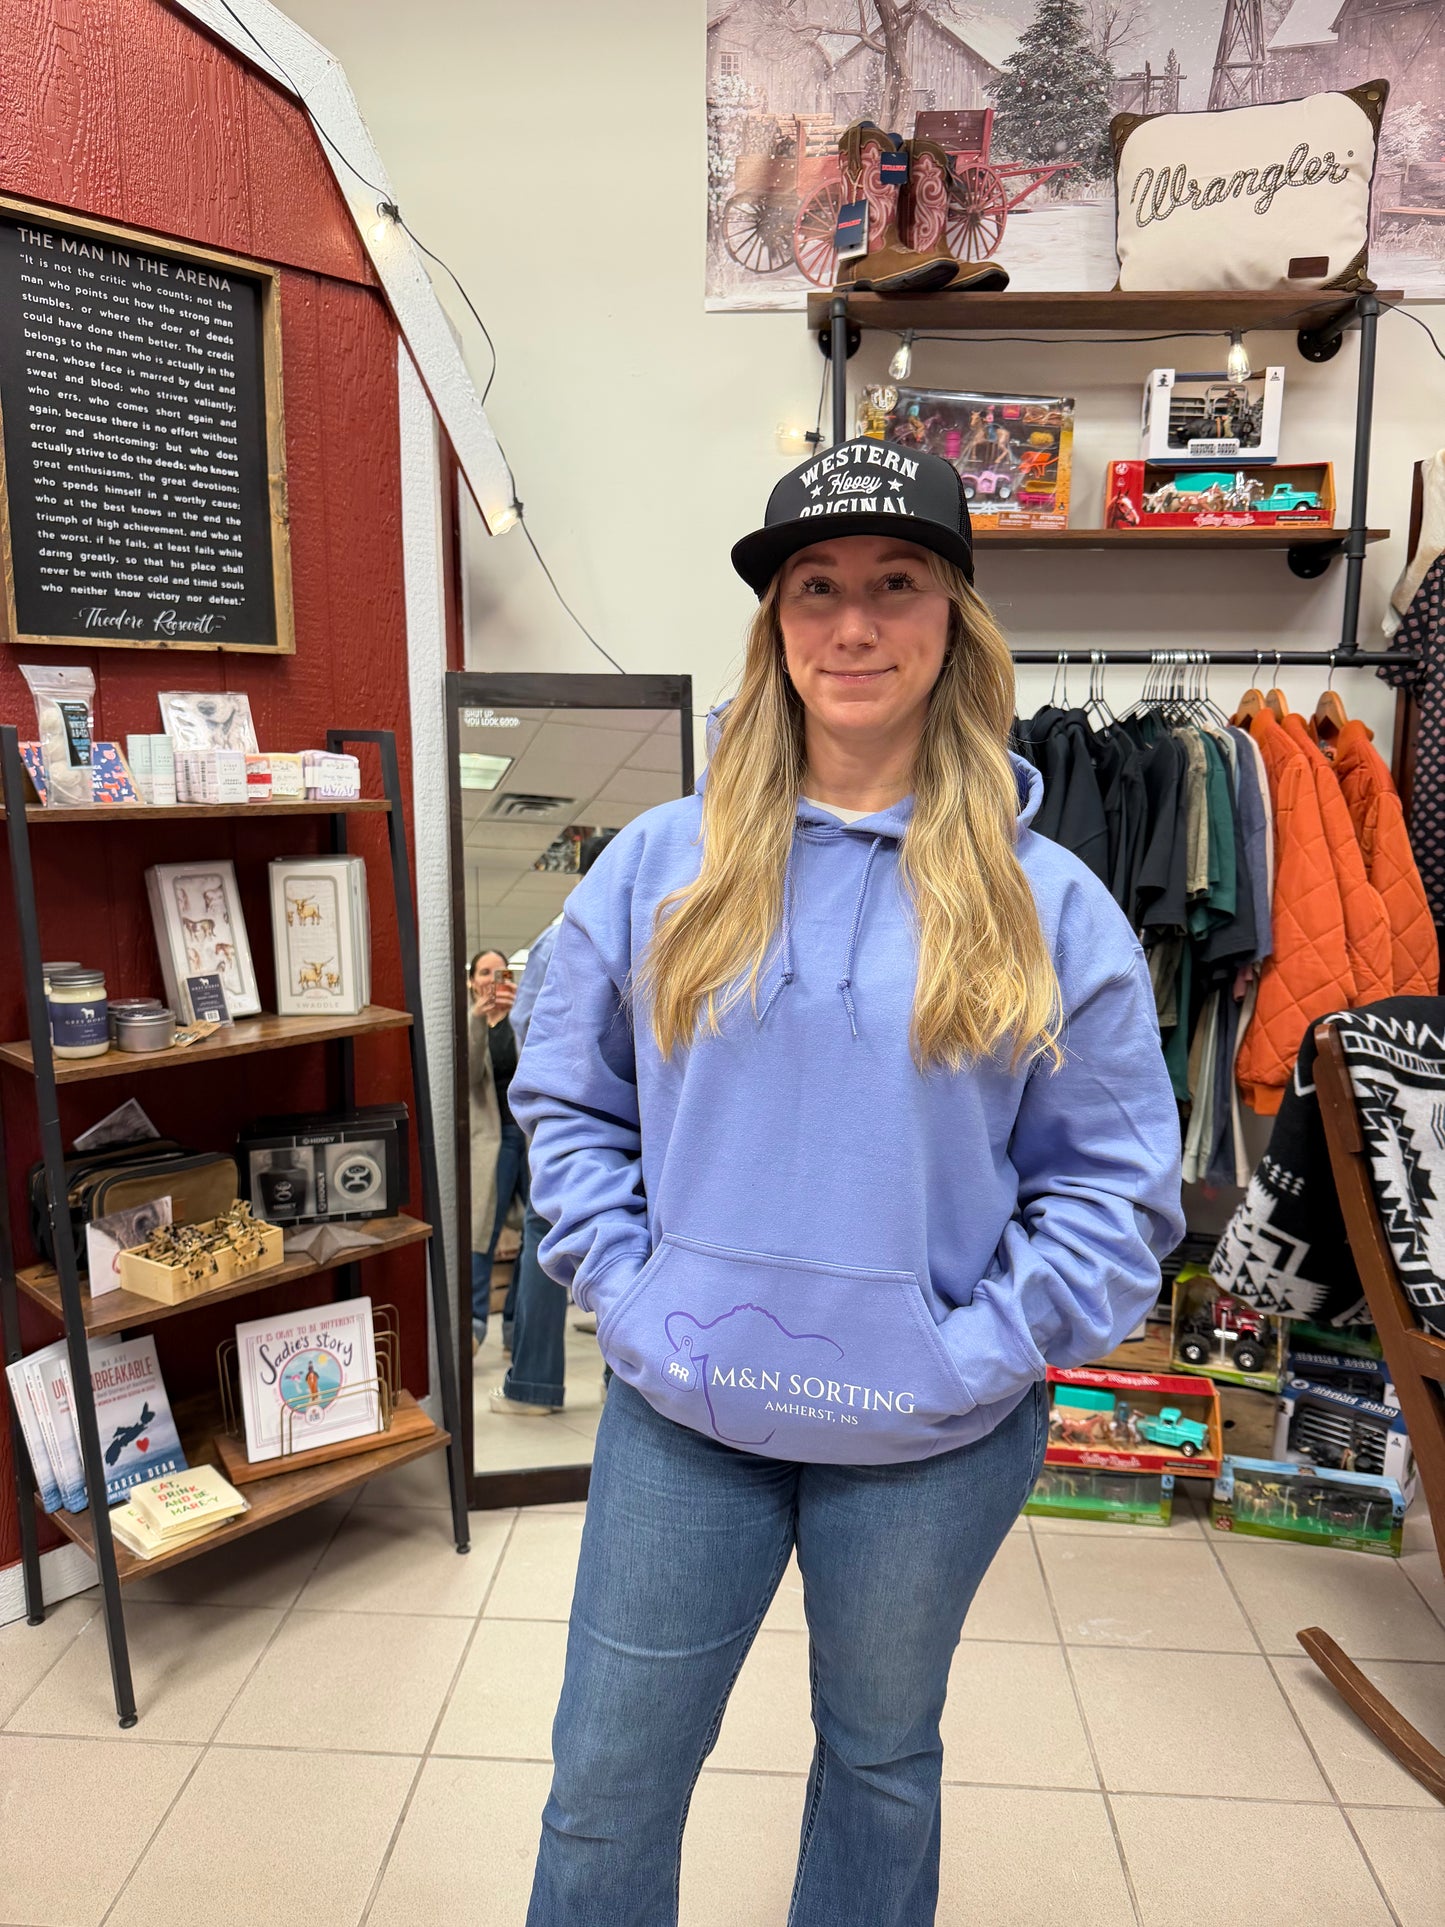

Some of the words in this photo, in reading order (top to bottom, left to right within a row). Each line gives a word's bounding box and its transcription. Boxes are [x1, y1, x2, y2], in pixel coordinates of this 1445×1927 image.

[1130, 143, 1349, 228] Wrangler
[18, 227, 54, 249] THE
[62, 238, 104, 261] MAN
[112, 251, 130, 268] IN
[137, 257, 169, 277] THE
[175, 268, 231, 292] ARENA
[20, 274, 44, 285] man
[48, 280, 71, 291] who
[75, 286, 108, 300] points
[112, 295, 130, 305] out
[134, 297, 155, 310] how
[158, 304, 175, 315] the
[179, 310, 210, 325] strong
[213, 318, 233, 328] man
[39, 258, 49, 268] is
[54, 263, 72, 274] not
[77, 267, 95, 279] the
[99, 274, 126, 287] critic
[131, 281, 152, 292] who
[197, 297, 213, 307] not
[217, 300, 233, 311] the
[23, 312, 53, 324] could
[58, 317, 83, 331] have
[87, 324, 113, 337] done
[118, 330, 144, 343] them
[148, 336, 181, 351] better.
[185, 343, 203, 355] The
[207, 350, 234, 362] credit
[81, 306, 92, 314] or
[99, 309, 130, 323] where
[137, 317, 154, 328] the
[160, 322, 183, 334] doer
[189, 328, 200, 337] of
[206, 331, 234, 345] deeds
[24, 328, 67, 347] belongs
[70, 338, 82, 348] to
[85, 341, 103, 353] the
[106, 347, 128, 357] man
[131, 351, 152, 362] who
[166, 359, 205, 374] actually
[207, 365, 217, 375] in
[219, 368, 235, 379] the
[62, 355, 96, 369] whose
[100, 361, 123, 374] face
[127, 367, 136, 377] is
[140, 371, 174, 384] marred
[178, 376, 190, 389] by
[193, 380, 215, 391] dust
[218, 386, 236, 395] and
[30, 423, 57, 433] error
[65, 428, 85, 438] and
[165, 442, 182, 453] but
[189, 446, 210, 457] who
[216, 450, 238, 461] does
[799, 444, 919, 488] WESTERN
[827, 470, 882, 497] Hooey
[36, 512, 78, 525] triumph
[81, 517, 93, 526] of
[96, 518, 120, 531] high
[190, 529, 207, 538] and
[210, 531, 230, 541] who
[232, 534, 242, 542] at
[37, 530, 55, 540] the
[96, 535, 104, 544] if
[108, 536, 121, 546] he
[153, 542, 163, 550] at
[167, 542, 191, 553] least
[194, 545, 215, 555] fails
[218, 548, 243, 558] while
[38, 547, 73, 561] daring
[125, 557, 137, 565] so
[143, 557, 164, 567] that
[170, 559, 185, 569] his
[191, 561, 216, 572] place
[222, 564, 244, 574] shall
[40, 567, 69, 576] never
[73, 568, 86, 577] be
[90, 570, 113, 579] with
[116, 572, 144, 582] those
[147, 574, 169, 584] cold
[172, 577, 190, 586] and
[193, 578, 218, 588] timid
[221, 581, 245, 590] souls
[41, 583, 63, 593] who
[70, 586, 108, 596] neither
[114, 588, 141, 598] know
[147, 591, 180, 603] victory
[186, 595, 203, 603] nor
[464, 717, 480, 727] YOU
[481, 717, 499, 727] LOOK
[484, 709, 494, 718] UP
[310, 1136, 335, 1144] HOOEY
[316, 1332, 353, 1367] story
[91, 1356, 153, 1391] BREAKABLE
[711, 1366, 780, 1392] M&N
[789, 1374, 916, 1414] SORTING
[765, 1401, 836, 1424] AMHERST,
[841, 1414, 859, 1426] NS
[107, 1473, 142, 1493] KAREN
[148, 1460, 176, 1478] DEAN
[157, 1485, 199, 1502] DRINK
[165, 1495, 191, 1508] AND
